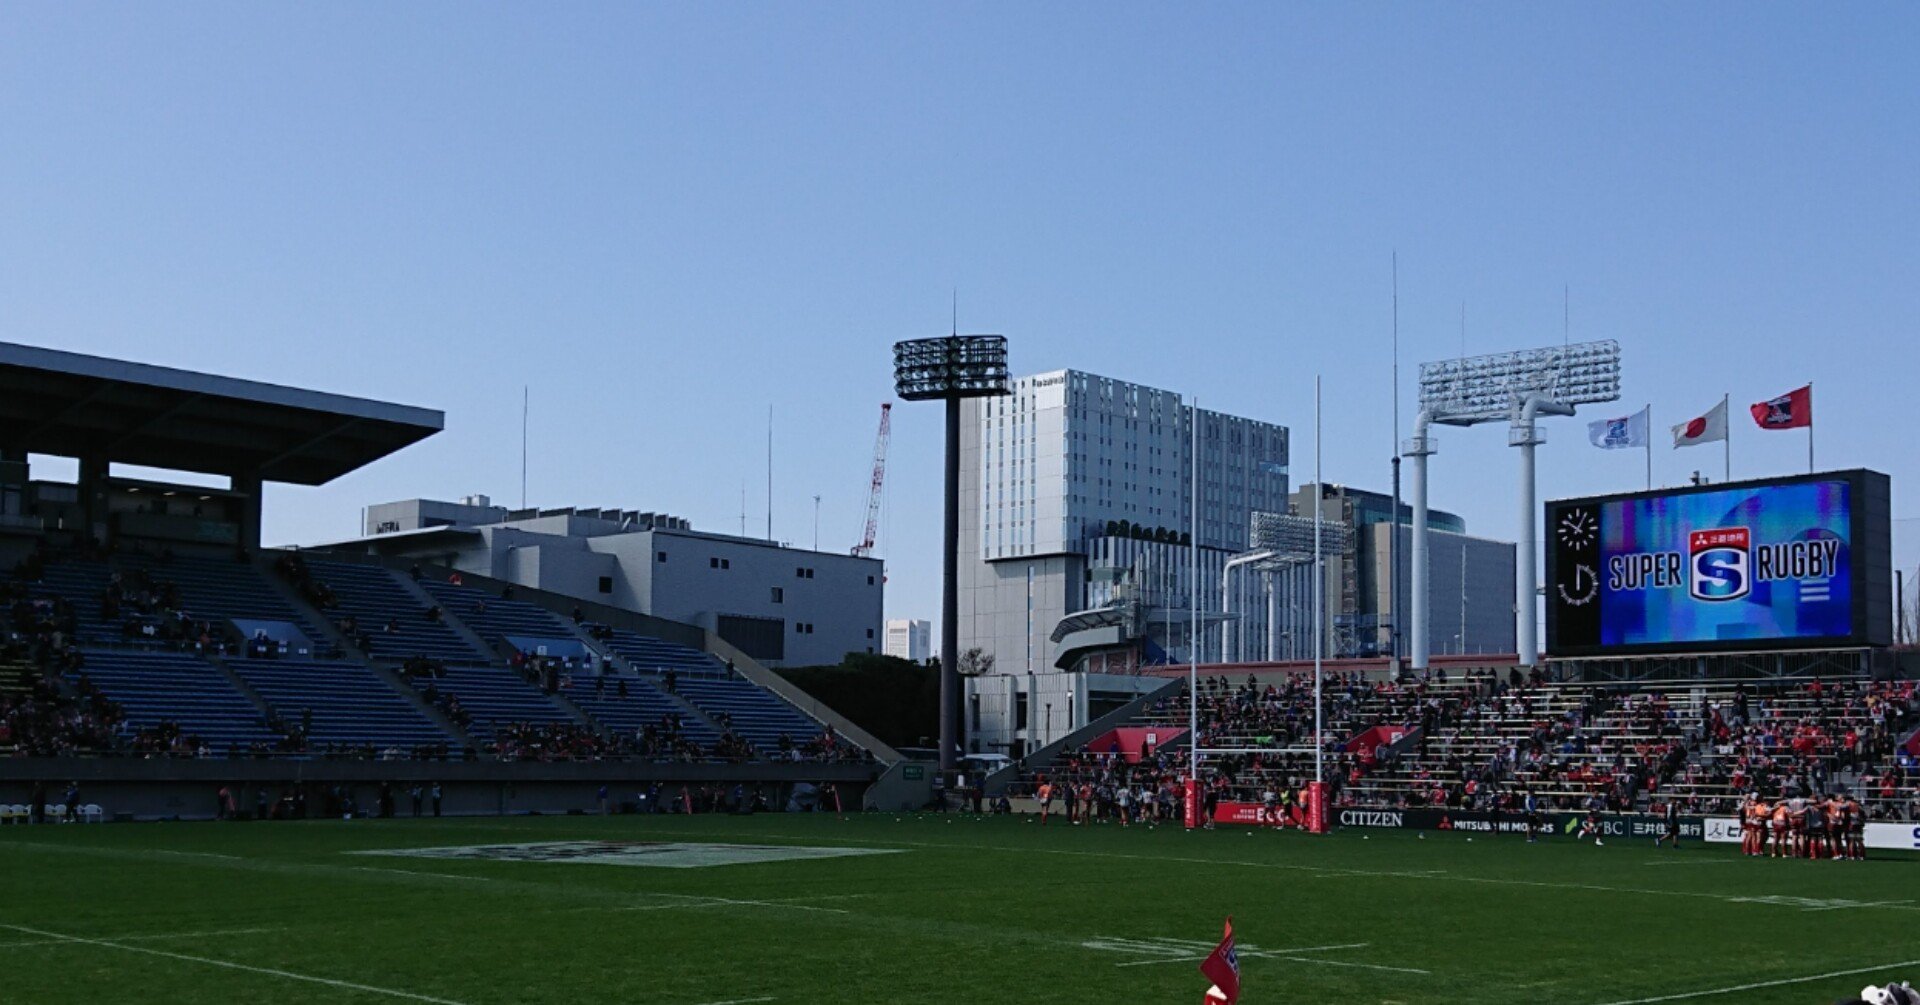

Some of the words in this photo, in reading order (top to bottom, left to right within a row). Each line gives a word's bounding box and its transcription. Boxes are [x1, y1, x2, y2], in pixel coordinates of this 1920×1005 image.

[1609, 552, 1682, 591] SUPER
[1757, 540, 1840, 580] RUGBY
[1697, 550, 1742, 596] S
[1340, 810, 1404, 827] CITIZEN
